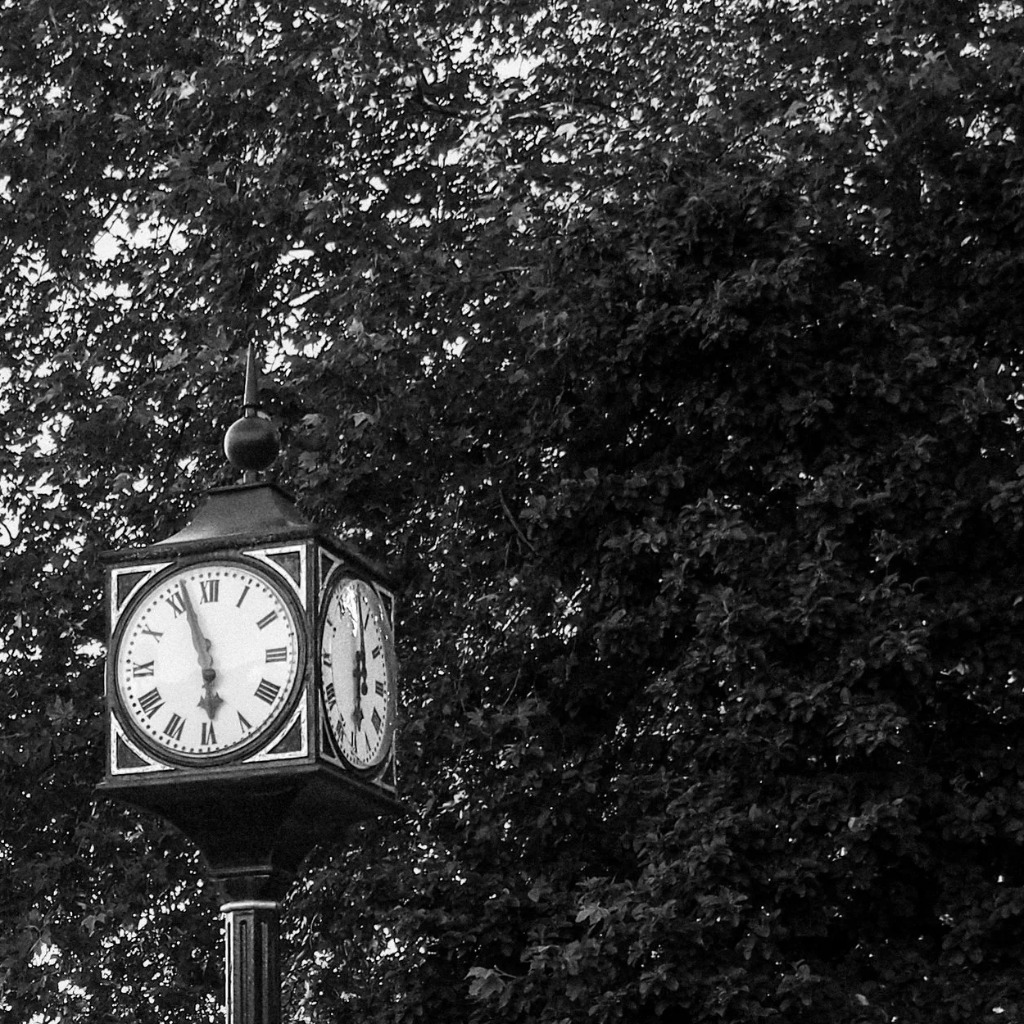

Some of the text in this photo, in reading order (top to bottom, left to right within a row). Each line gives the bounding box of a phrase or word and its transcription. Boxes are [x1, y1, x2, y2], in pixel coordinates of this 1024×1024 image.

[165, 590, 186, 619] XI
[199, 579, 220, 605] XII
[236, 585, 250, 608] I
[256, 610, 278, 630] II
[141, 623, 163, 643] X
[265, 646, 288, 664] III
[132, 659, 155, 678] IX
[137, 686, 166, 720] VIII
[254, 677, 281, 706] IIII
[163, 712, 187, 741] VII
[201, 719, 217, 746] VI
[237, 710, 252, 734] V
